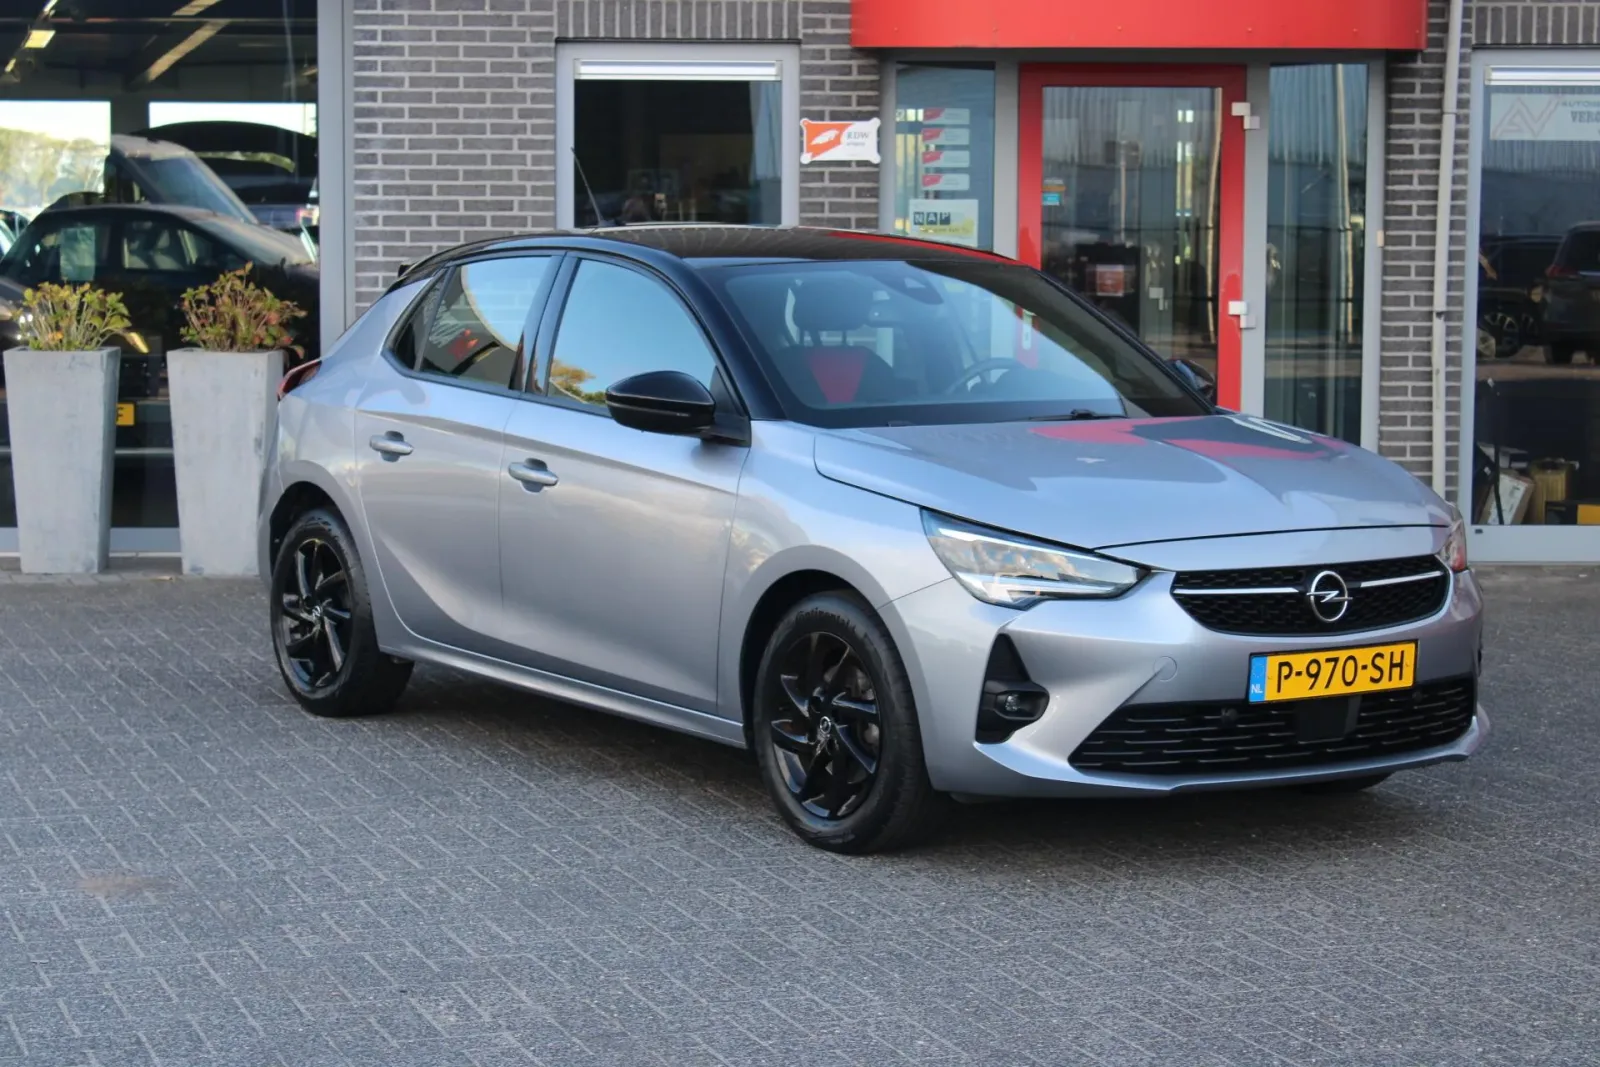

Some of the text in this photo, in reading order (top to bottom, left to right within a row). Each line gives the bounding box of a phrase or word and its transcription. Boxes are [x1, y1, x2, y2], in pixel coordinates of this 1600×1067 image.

[847, 131, 869, 141] RDW
[914, 211, 950, 225] NAP
[1276, 650, 1405, 694] P-970-SH
[1251, 683, 1263, 694] NL
